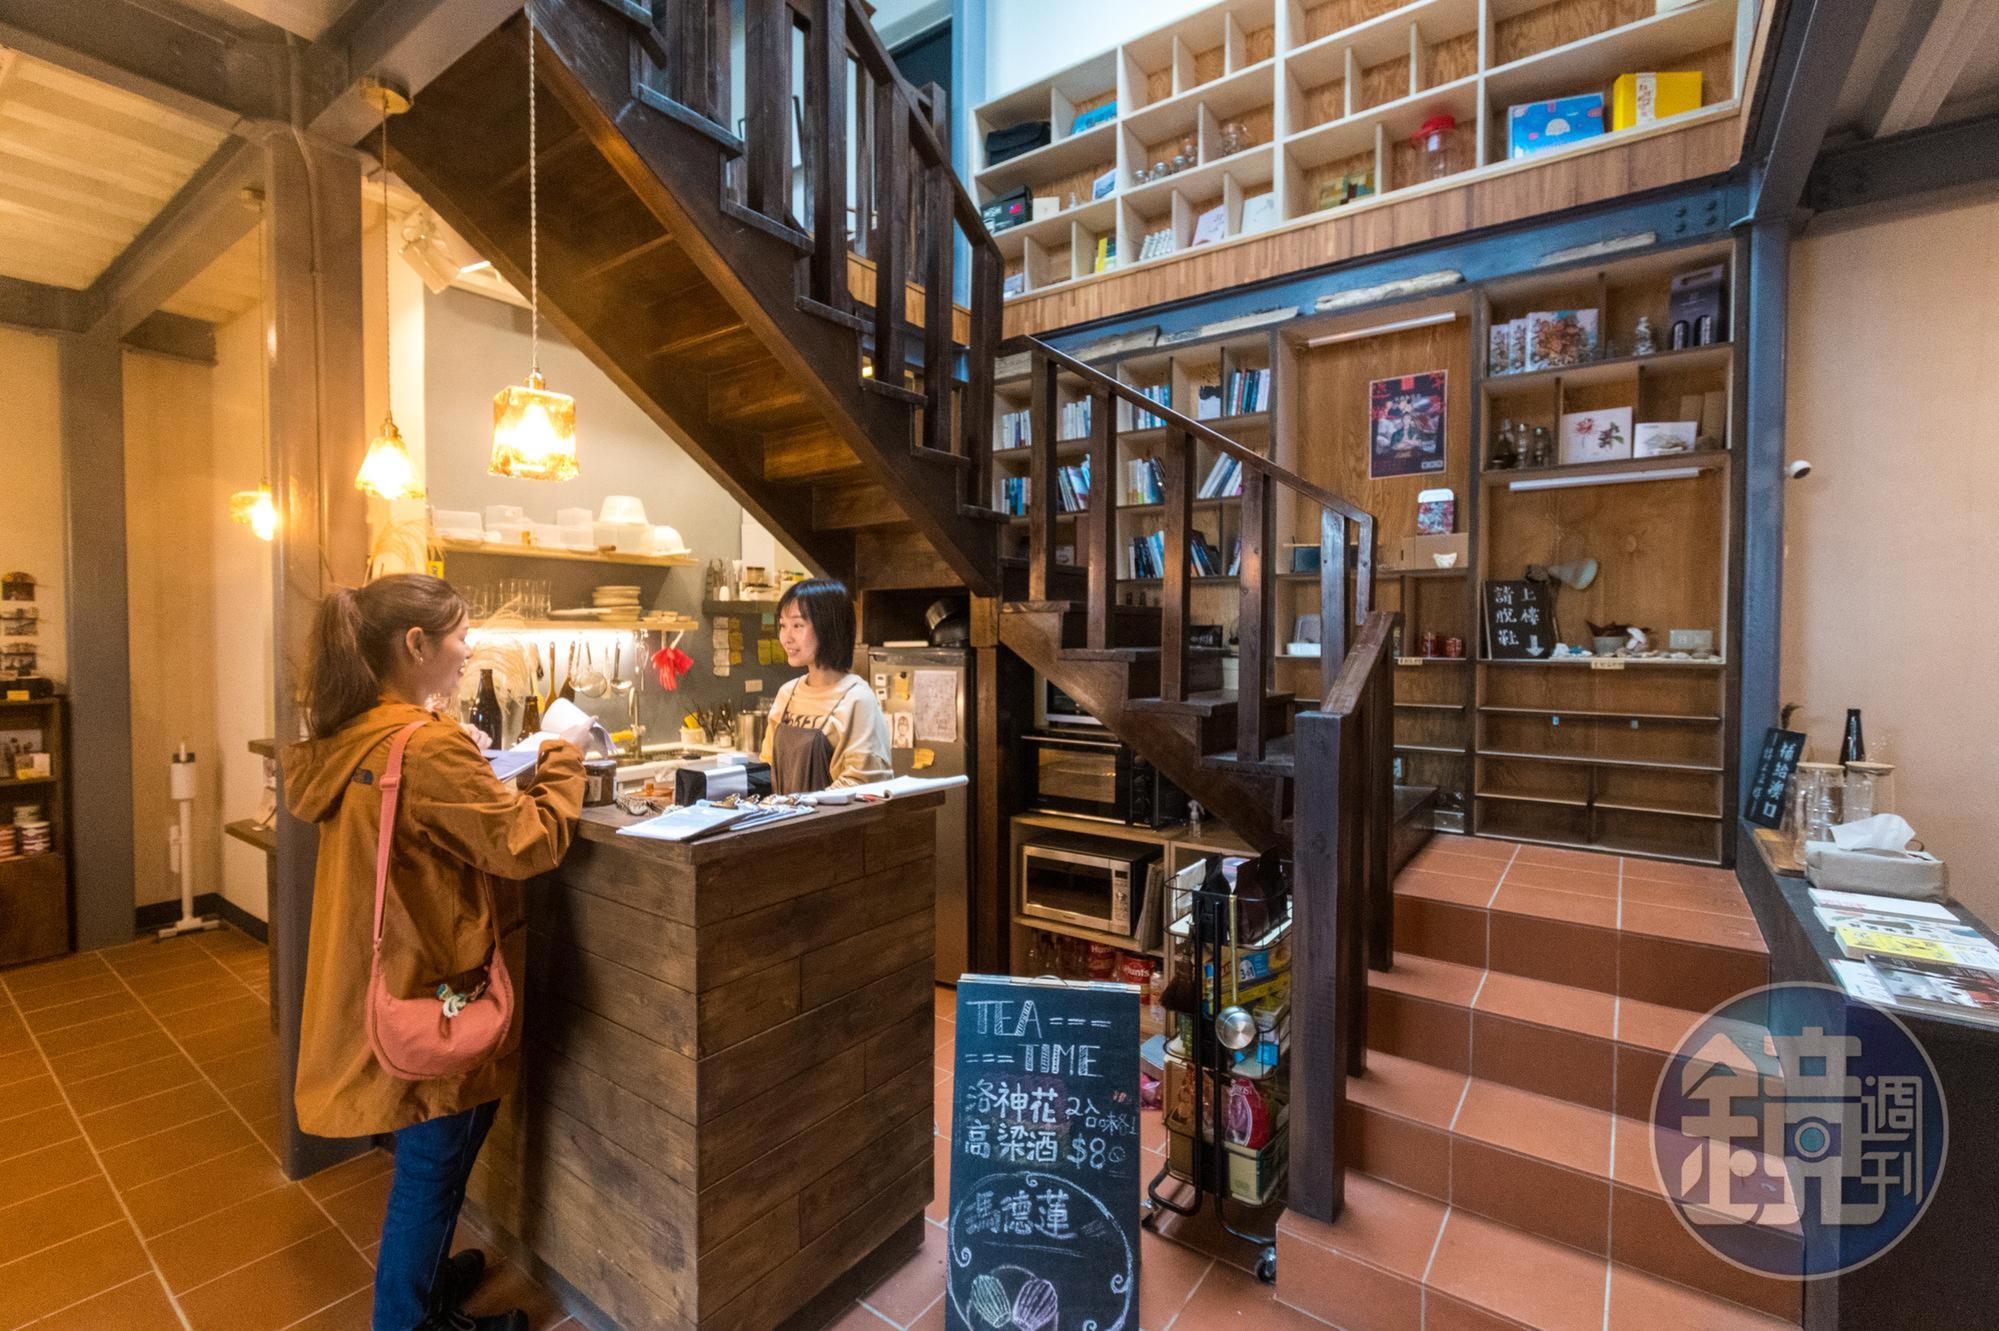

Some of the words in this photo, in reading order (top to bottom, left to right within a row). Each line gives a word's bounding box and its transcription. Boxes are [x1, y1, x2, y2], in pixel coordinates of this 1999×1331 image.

[1521, 587, 1540, 626] 上樓
[965, 999, 1043, 1039] TEA
[1017, 1043, 1104, 1078] TIME
[965, 1078, 1059, 1124] 洛神花
